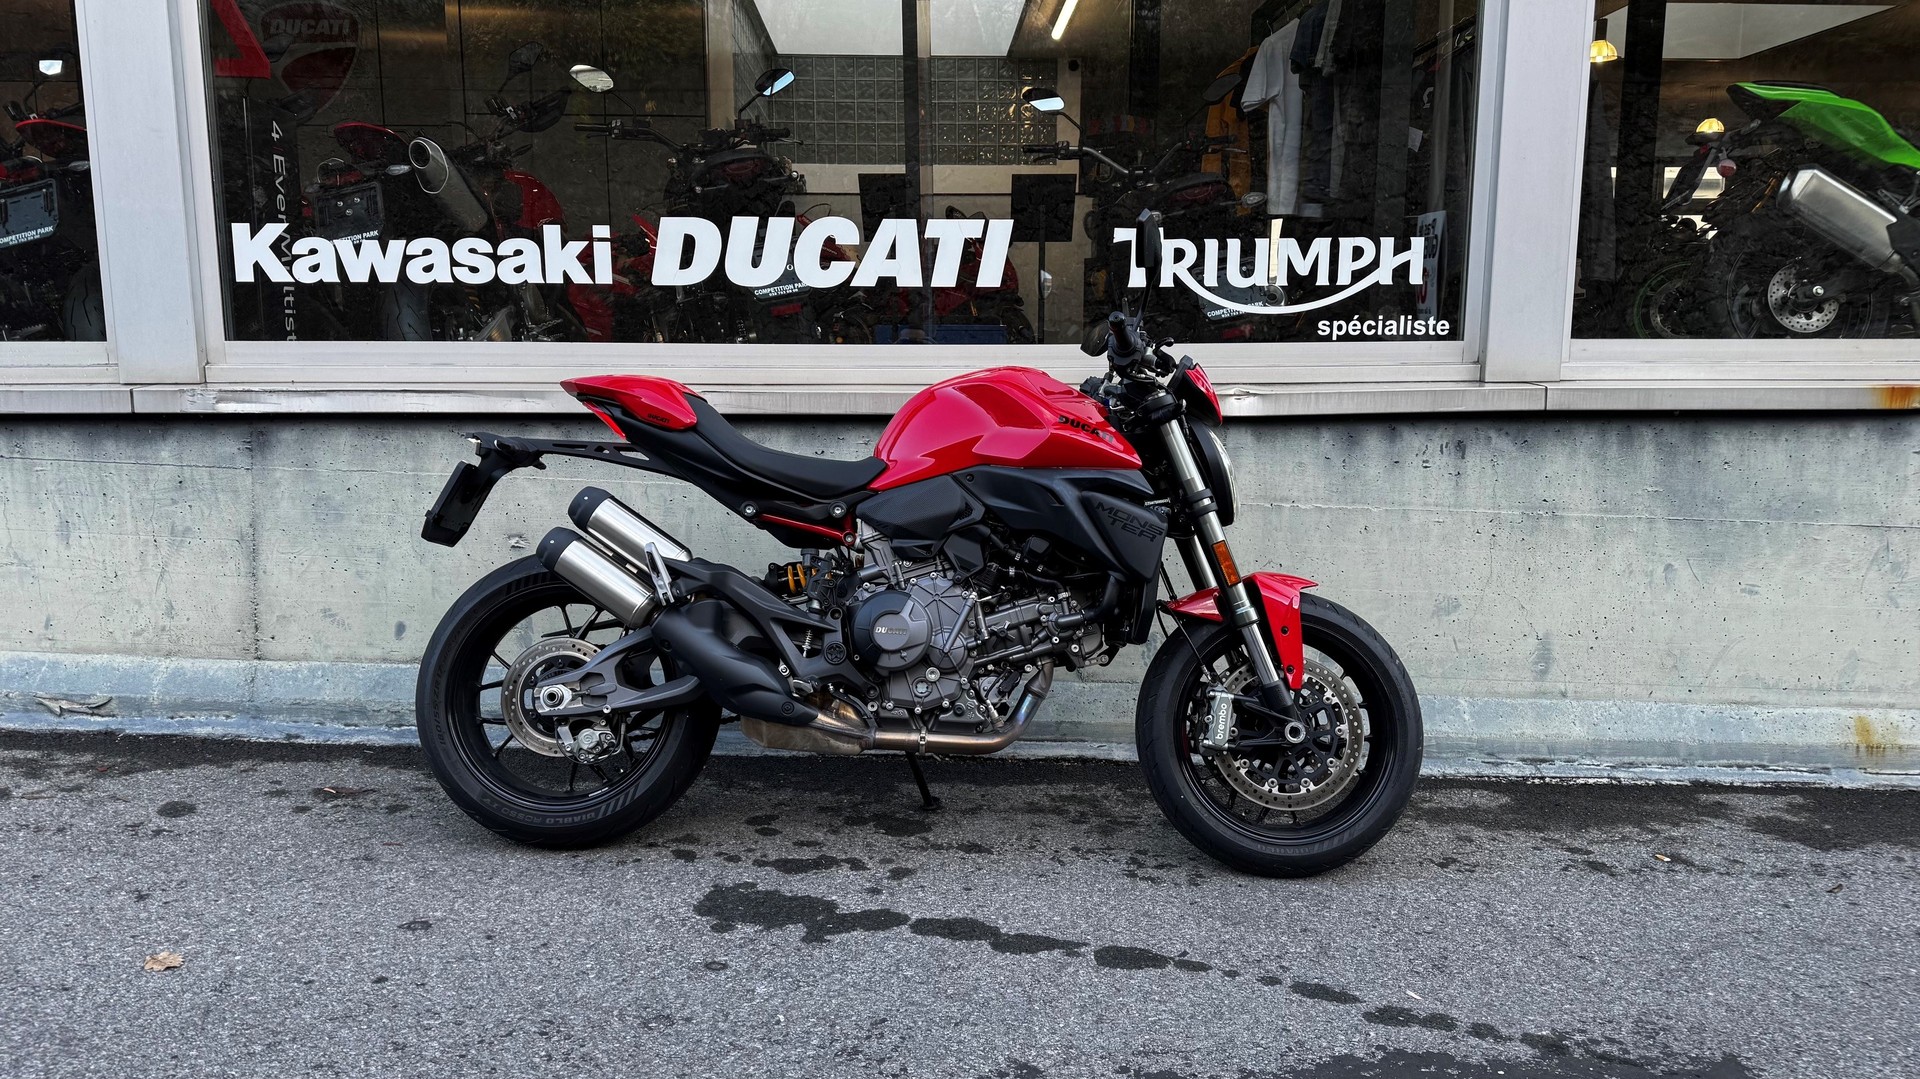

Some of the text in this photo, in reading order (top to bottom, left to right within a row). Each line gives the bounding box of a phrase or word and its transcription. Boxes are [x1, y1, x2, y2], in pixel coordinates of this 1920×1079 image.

[269, 19, 350, 35] DUCATI
[37, 226, 54, 234] PARK
[362, 230, 379, 238] PARK
[231, 222, 613, 285] Kawasaki
[651, 216, 1014, 289] DUCATI
[754, 284, 794, 295] COMPETITION
[1317, 314, 1450, 341] spécialiste
[1058, 415, 1114, 443] DUCATI
[1215, 703, 1228, 740] brembo
[500, 807, 543, 823] ROSSO
[545, 812, 596, 824] DIABLO
